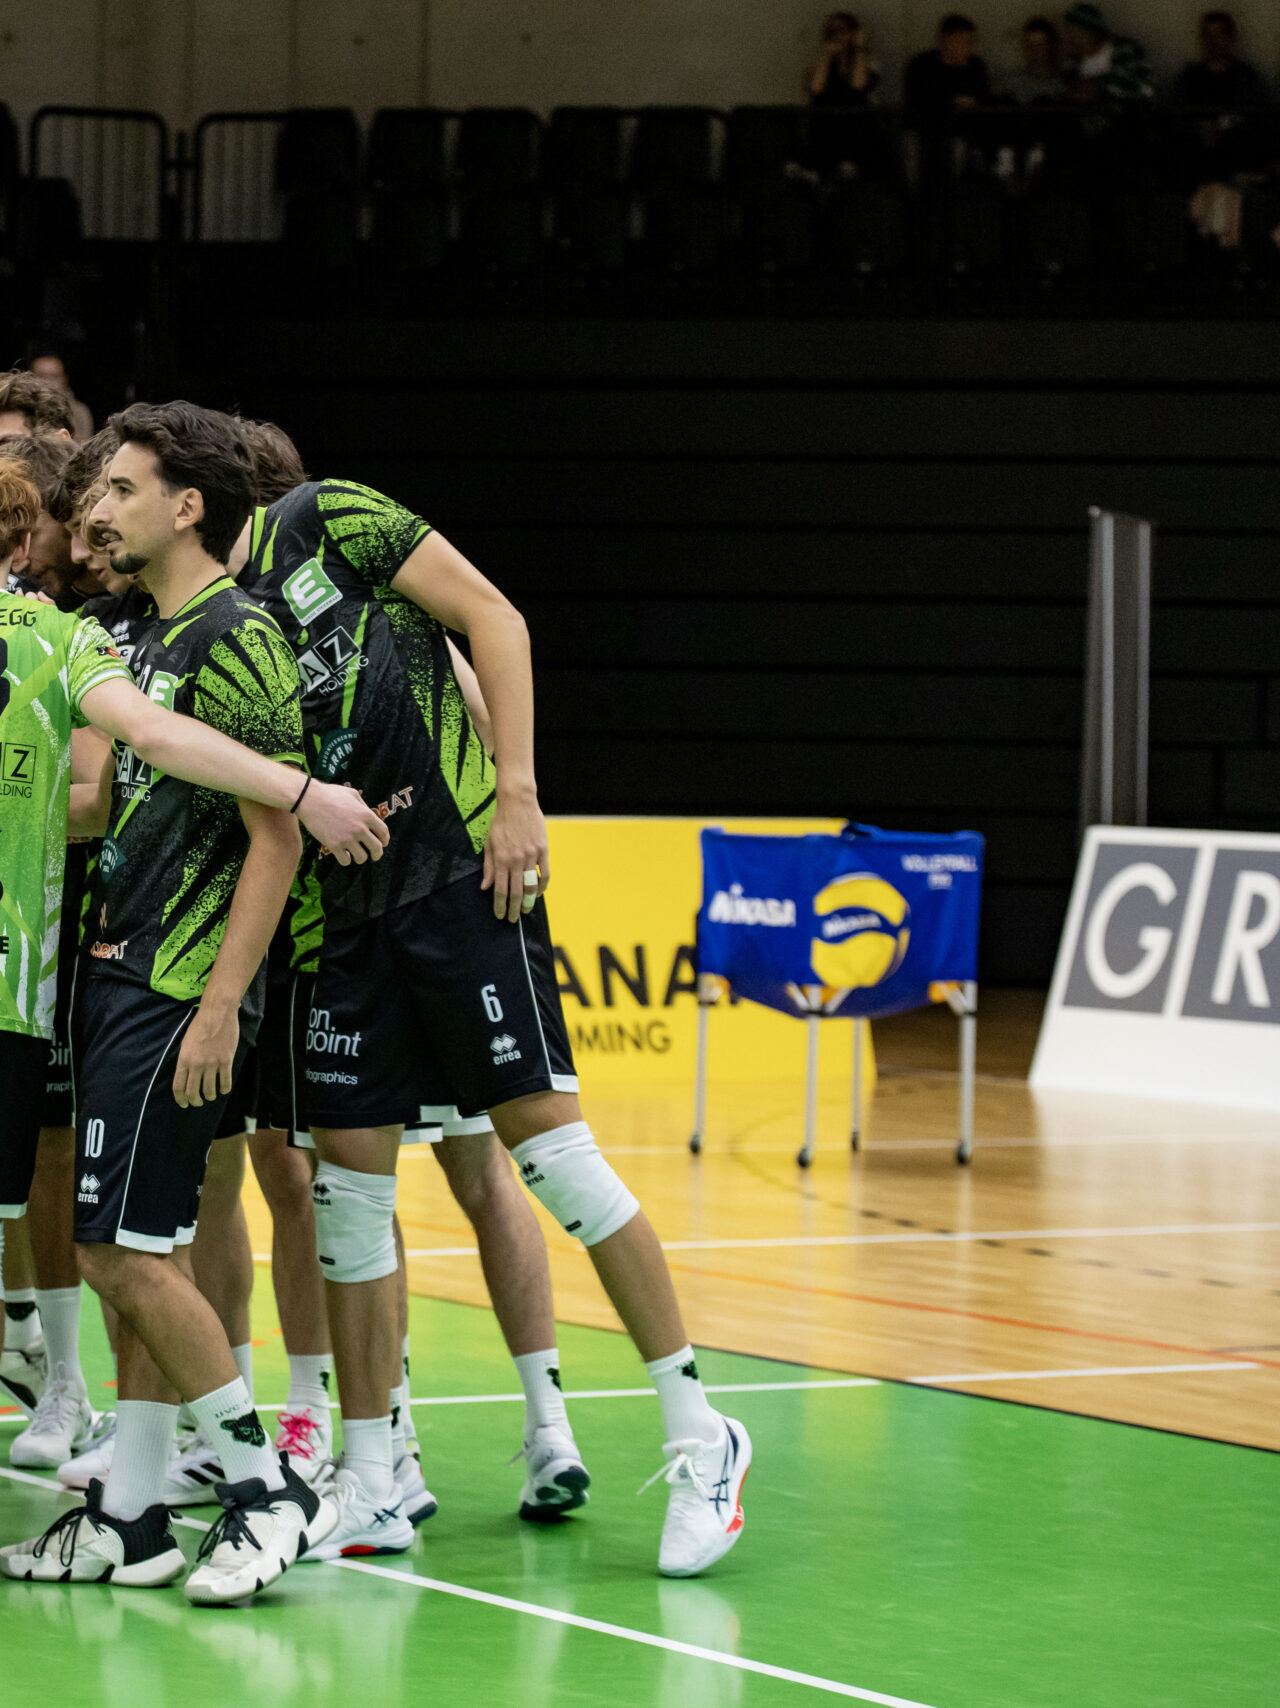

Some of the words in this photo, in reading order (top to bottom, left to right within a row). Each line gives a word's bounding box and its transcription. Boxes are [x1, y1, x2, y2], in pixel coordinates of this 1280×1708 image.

[318, 655, 369, 696] HOLDING
[328, 741, 354, 775] GRAN
[309, 1007, 330, 1031] on
[481, 983, 504, 1023] 6
[493, 1049, 523, 1066] errea
[84, 1117, 106, 1159] 10
[77, 1191, 99, 1205] errea
